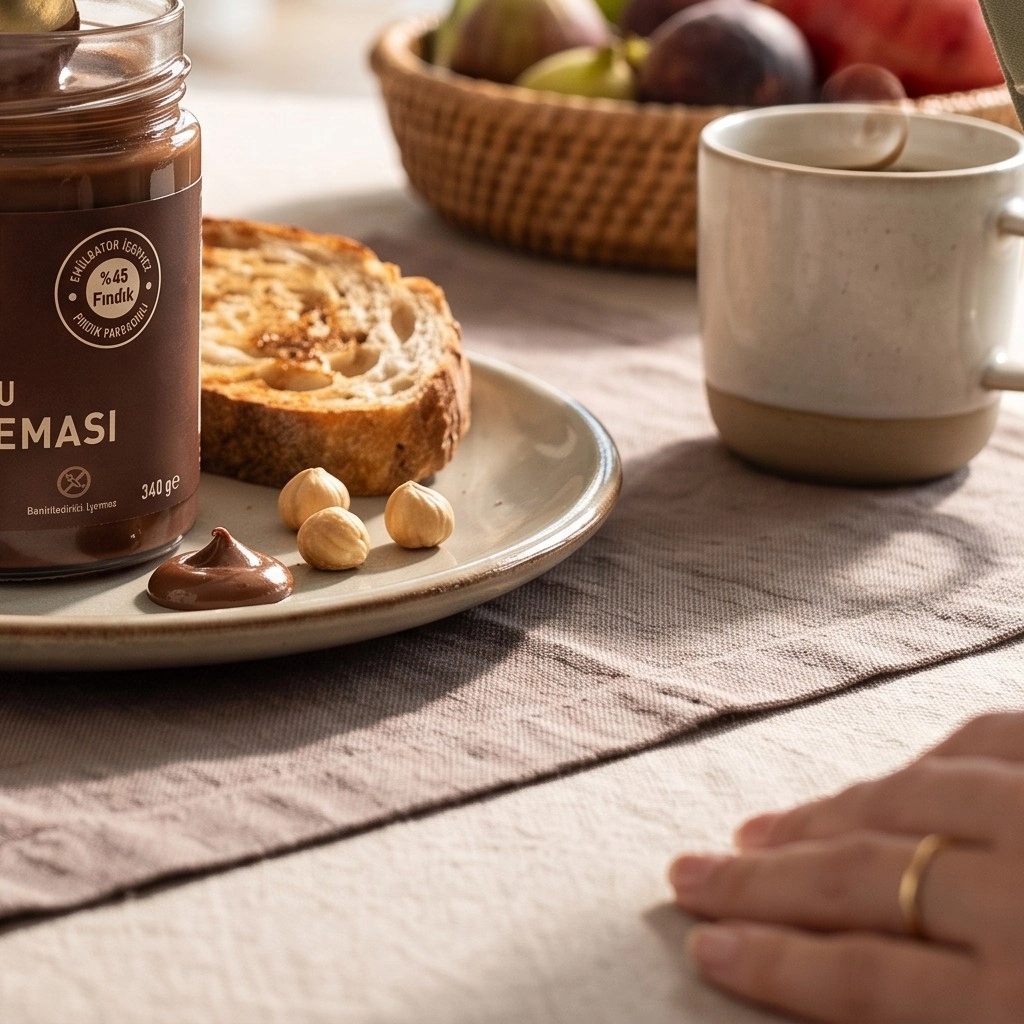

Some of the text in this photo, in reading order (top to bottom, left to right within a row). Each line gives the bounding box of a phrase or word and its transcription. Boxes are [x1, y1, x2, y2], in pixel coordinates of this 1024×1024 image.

[100, 267, 128, 286] %45
[93, 287, 134, 307] Fındık
[141, 478, 162, 500] 340
